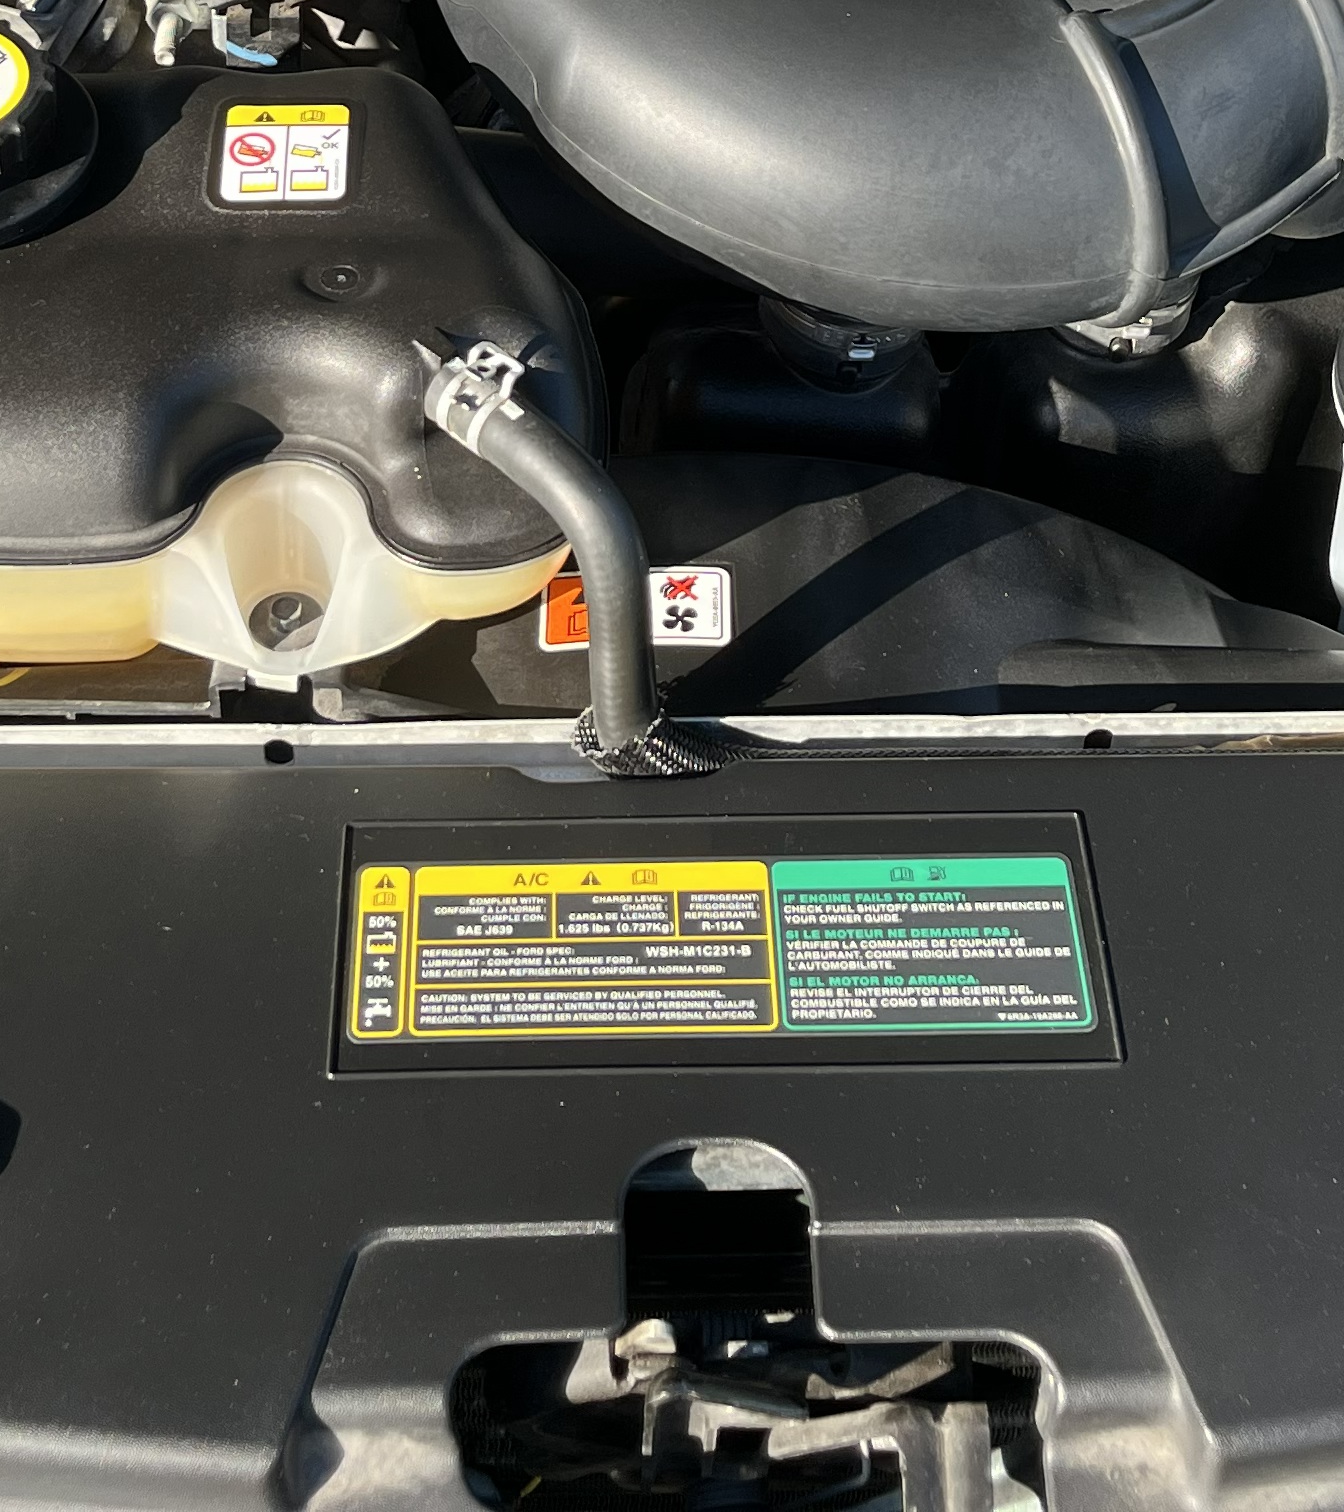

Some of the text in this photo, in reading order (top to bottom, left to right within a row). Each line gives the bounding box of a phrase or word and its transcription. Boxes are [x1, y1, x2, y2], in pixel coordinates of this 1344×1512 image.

[514, 873, 549, 886] A/C
[469, 897, 517, 905] COMPLIES
[592, 895, 632, 903] CHARGE
[783, 894, 795, 903] IF
[800, 894, 851, 903] ENGINE
[855, 893, 893, 902] FAILS
[897, 892, 915, 902] TO
[434, 906, 484, 915] CONFORME
[509, 906, 541, 914] NORME
[784, 901, 1064, 914] CHECK FUEL SHUTOFF SWITCH AS REFERENCED IN
[369, 916, 397, 928] 50%
[568, 913, 603, 921] CARGA
[784, 915, 816, 924] YOUR
[819, 914, 861, 924] OWNER
[456, 925, 513, 936] SAE J639
[558, 921, 674, 934] 1.625 lbs (0.737Kg)
[702, 920, 744, 931] R-134A
[786, 930, 799, 939] SI
[803, 930, 820, 939] LE
[825, 929, 883, 939] MOTEUR
[887, 929, 906, 938] NE
[984, 927, 1010, 937] PAS
[842, 941, 857, 949] LA
[859, 939, 928, 949] COMMANDE
[931, 939, 947, 948] DE
[950, 938, 1007, 947] COUPURE
[1010, 937, 1026, 947] DE
[423, 948, 491, 957] REFRIGERANT
[493, 948, 509, 956] OIL
[517, 947, 543, 955] FORD
[645, 945, 752, 957] WSH-M1C231-B
[865, 947, 1071, 959] COMME DANS LE GUIDE DE
[422, 958, 479, 967] LUBRIFIANT
[487, 957, 542, 966] CONFORME
[568, 956, 604, 965] NORME
[606, 956, 633, 964] FORD
[422, 969, 441, 978] USE
[444, 968, 479, 977] ACEITE
[481, 968, 506, 976] PARA
[509, 967, 589, 976] REFRIGERANTES
[592, 966, 647, 975] CONFORME
[658, 965, 693, 973] NORMA
[366, 975, 394, 988] 50%
[789, 976, 904, 987] SI EL MOTOR NO
[471, 993, 510, 1002] SYSTEM
[513, 993, 525, 1001] TO
[528, 992, 541, 1001] BE
[544, 992, 592, 1000] SERVICED
[595, 992, 608, 1000] BY
[610, 991, 662, 999] QUALIFIED
[790, 985, 1034, 997] REVISE EL INTERRUPTOR DE CIERRE DEL
[515, 1003, 555, 1012] CONFIER
[642, 1001, 655, 1009] UN
[657, 1000, 712, 1009] PERSONNEL
[791, 998, 877, 1008] COMBUSTIBLE
[881, 998, 917, 1007] COMO
[920, 997, 936, 1007] SE
[940, 996, 980, 1006] INDICA
[983, 996, 1000, 1006] EN
[1002, 996, 1019, 1005] LA
[1053, 995, 1078, 1005] DEL
[493, 1014, 529, 1023] SISTEMA
[641, 1012, 658, 1020] POR
